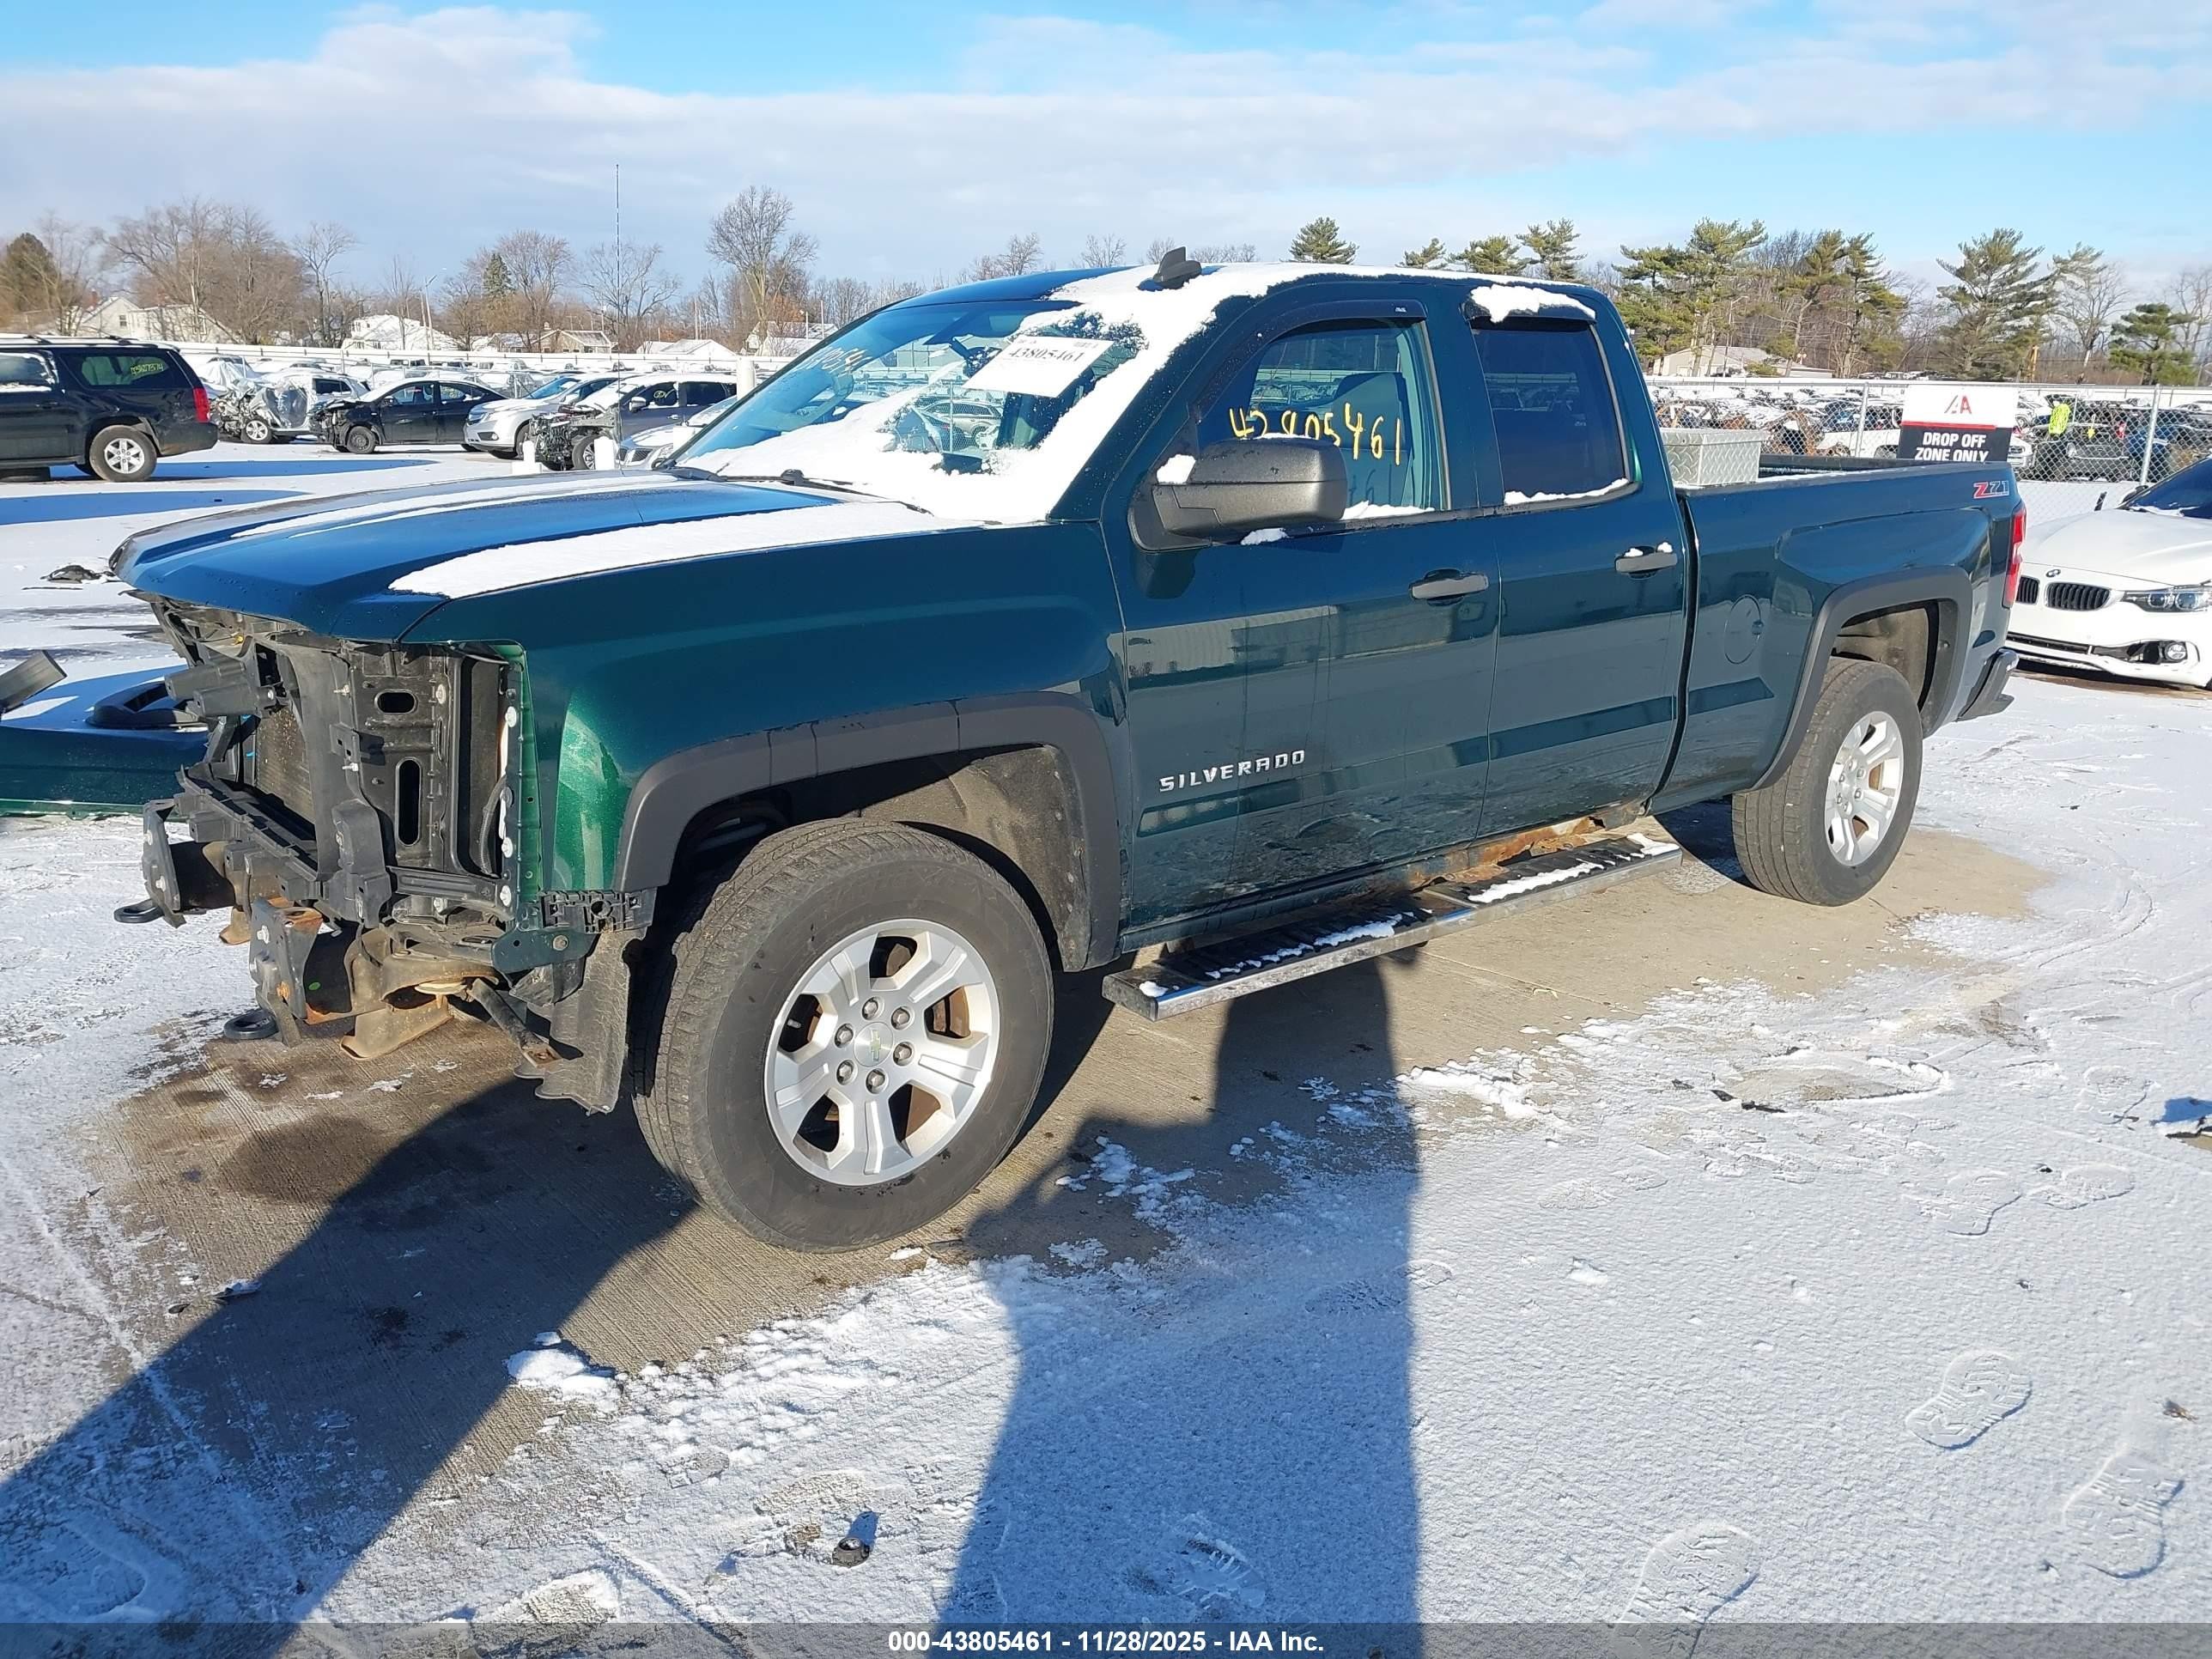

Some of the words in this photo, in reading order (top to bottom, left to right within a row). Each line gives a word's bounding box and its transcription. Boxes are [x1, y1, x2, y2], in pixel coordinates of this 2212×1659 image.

[1008, 346, 1085, 362] 43805461
[1923, 432, 1960, 447] DROP
[1960, 434, 1987, 448] OFF
[1914, 447, 1951, 461] ZONE
[1952, 449, 1990, 463] ONLY
[1973, 481, 2009, 499] Z71
[1159, 750, 1305, 793] SILVERADO
